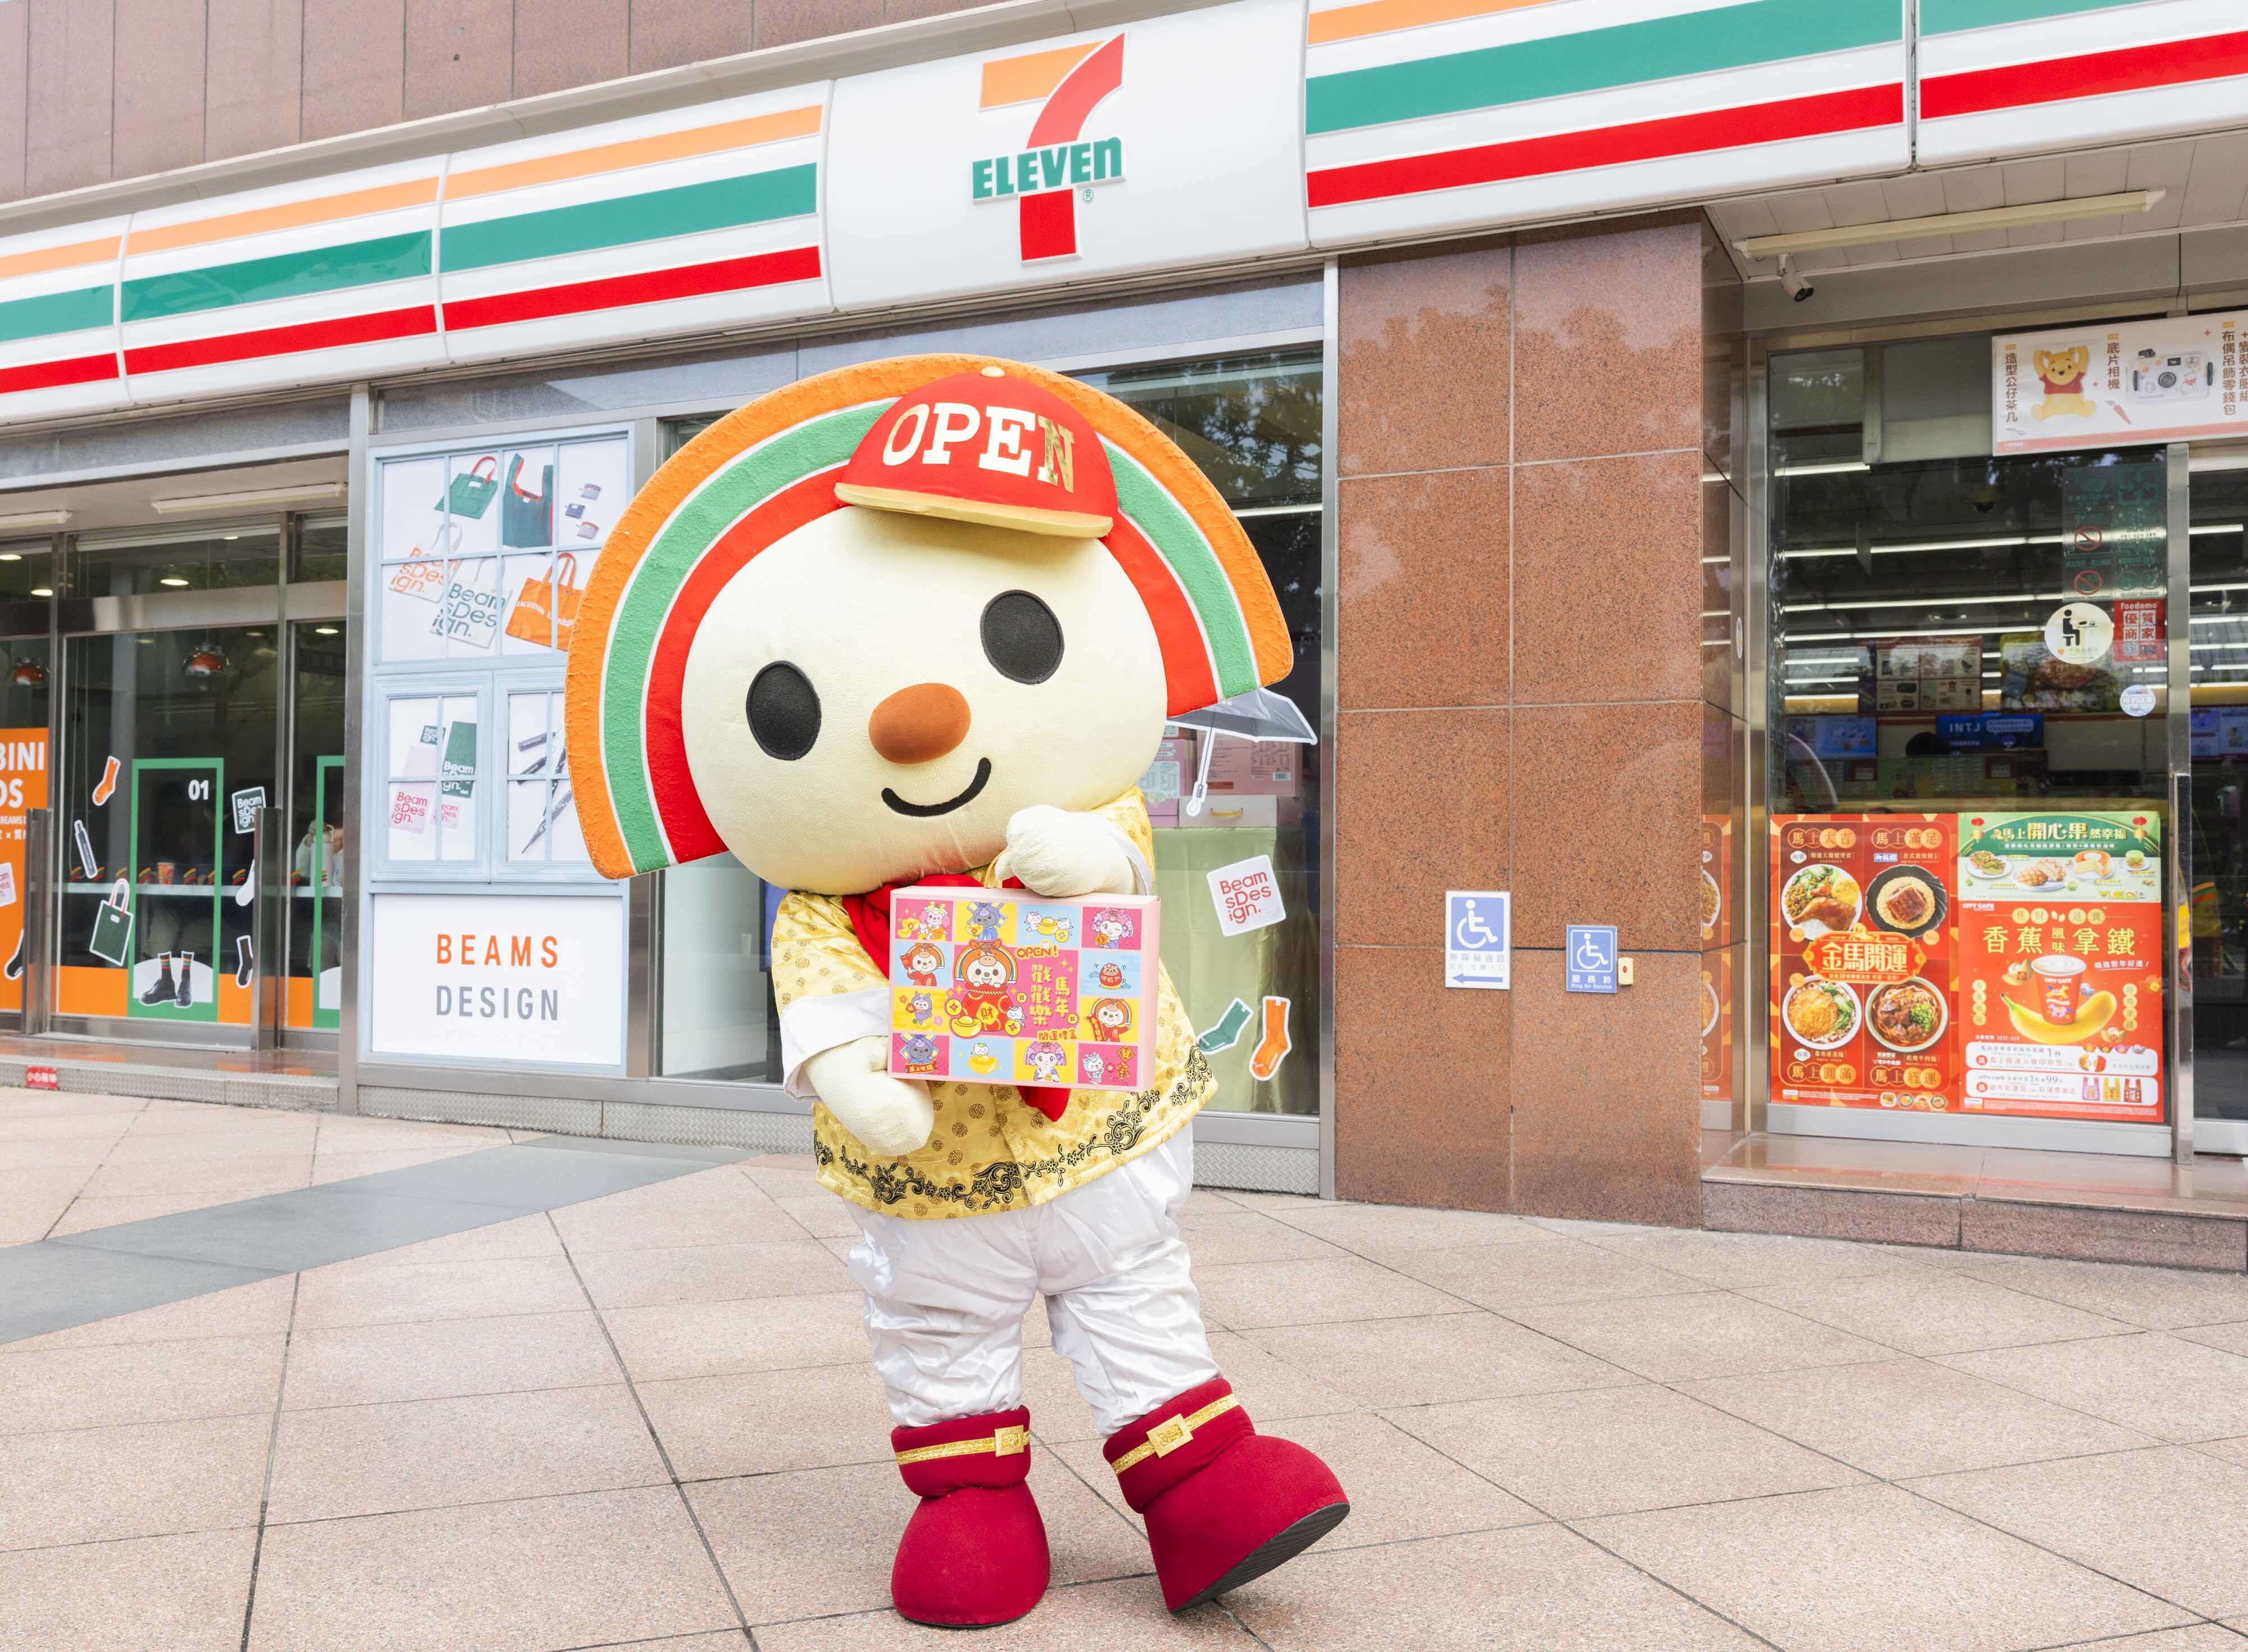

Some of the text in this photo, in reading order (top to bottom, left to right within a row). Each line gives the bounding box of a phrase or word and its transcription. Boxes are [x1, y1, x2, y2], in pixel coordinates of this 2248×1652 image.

[980, 32, 1125, 261] 7
[2108, 342, 2120, 389] 底片相機
[2222, 330, 2236, 415] 布偶吊飾零錢包
[2005, 353, 2018, 423] 造型公仔茶几
[883, 402, 1075, 493] OPEN
[448, 583, 506, 609] Beam
[2125, 612, 2155, 625] 優質
[2125, 628, 2155, 639] 商家
[1950, 722, 1980, 733] INTJ
[443, 761, 474, 774] Beam
[188, 779, 209, 800] 01
[397, 791, 428, 806] Beam
[237, 796, 262, 809] Beam
[395, 802, 425, 817] sDes
[391, 811, 413, 824] ign.
[1792, 832, 1851, 845] 馬上大吉
[1876, 831, 1939, 845] 馬上滿足
[1219, 872, 1268, 895] Beam
[1225, 886, 1271, 908] sDes
[1228, 904, 1261, 924] ign.
[437, 934, 558, 968] BEAMS
[1821, 941, 1907, 972] 金馬開運
[1572, 974, 1611, 983] 服務鈴
[437, 985, 558, 1020] DESIGN
[1030, 964, 1052, 1026] 戳戳樂
[1055, 976, 1071, 1018] 馬年
[980, 1007, 994, 1019] 財
[1039, 1029, 1077, 1041] 開運禮盒
